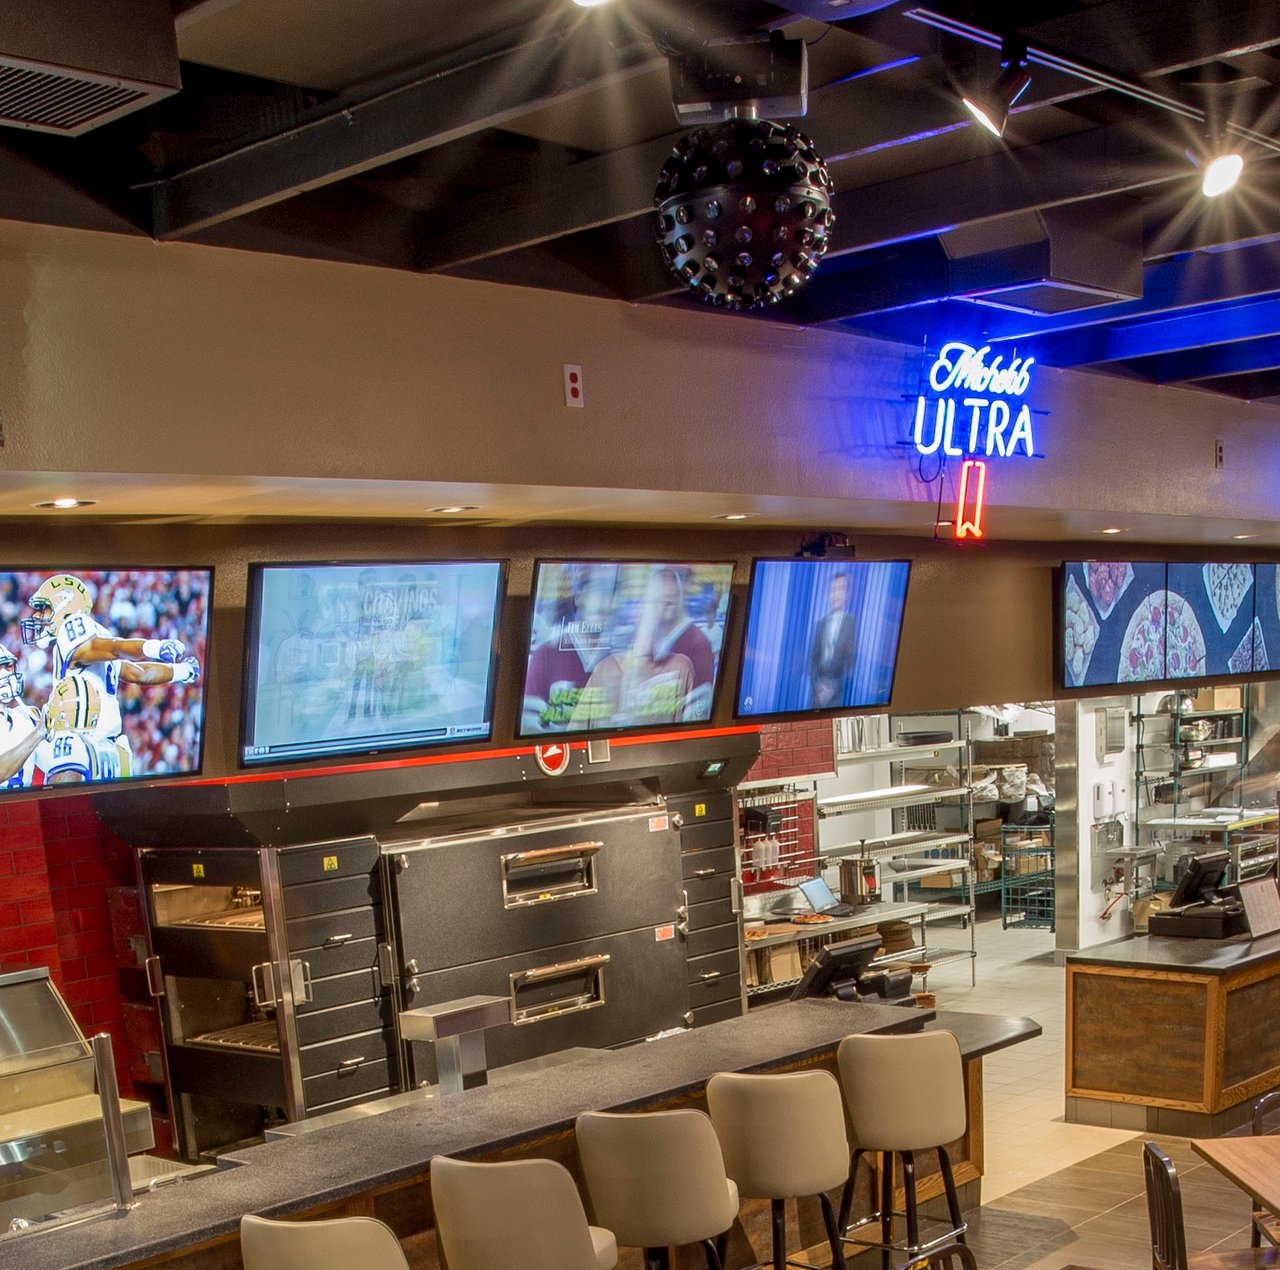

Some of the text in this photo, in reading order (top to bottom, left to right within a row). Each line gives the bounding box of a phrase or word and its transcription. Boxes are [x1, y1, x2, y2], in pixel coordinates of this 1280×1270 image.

[914, 395, 1034, 457] ULTRA
[51, 577, 86, 595] LSU
[64, 617, 86, 642] 83
[53, 736, 74, 760] 86
